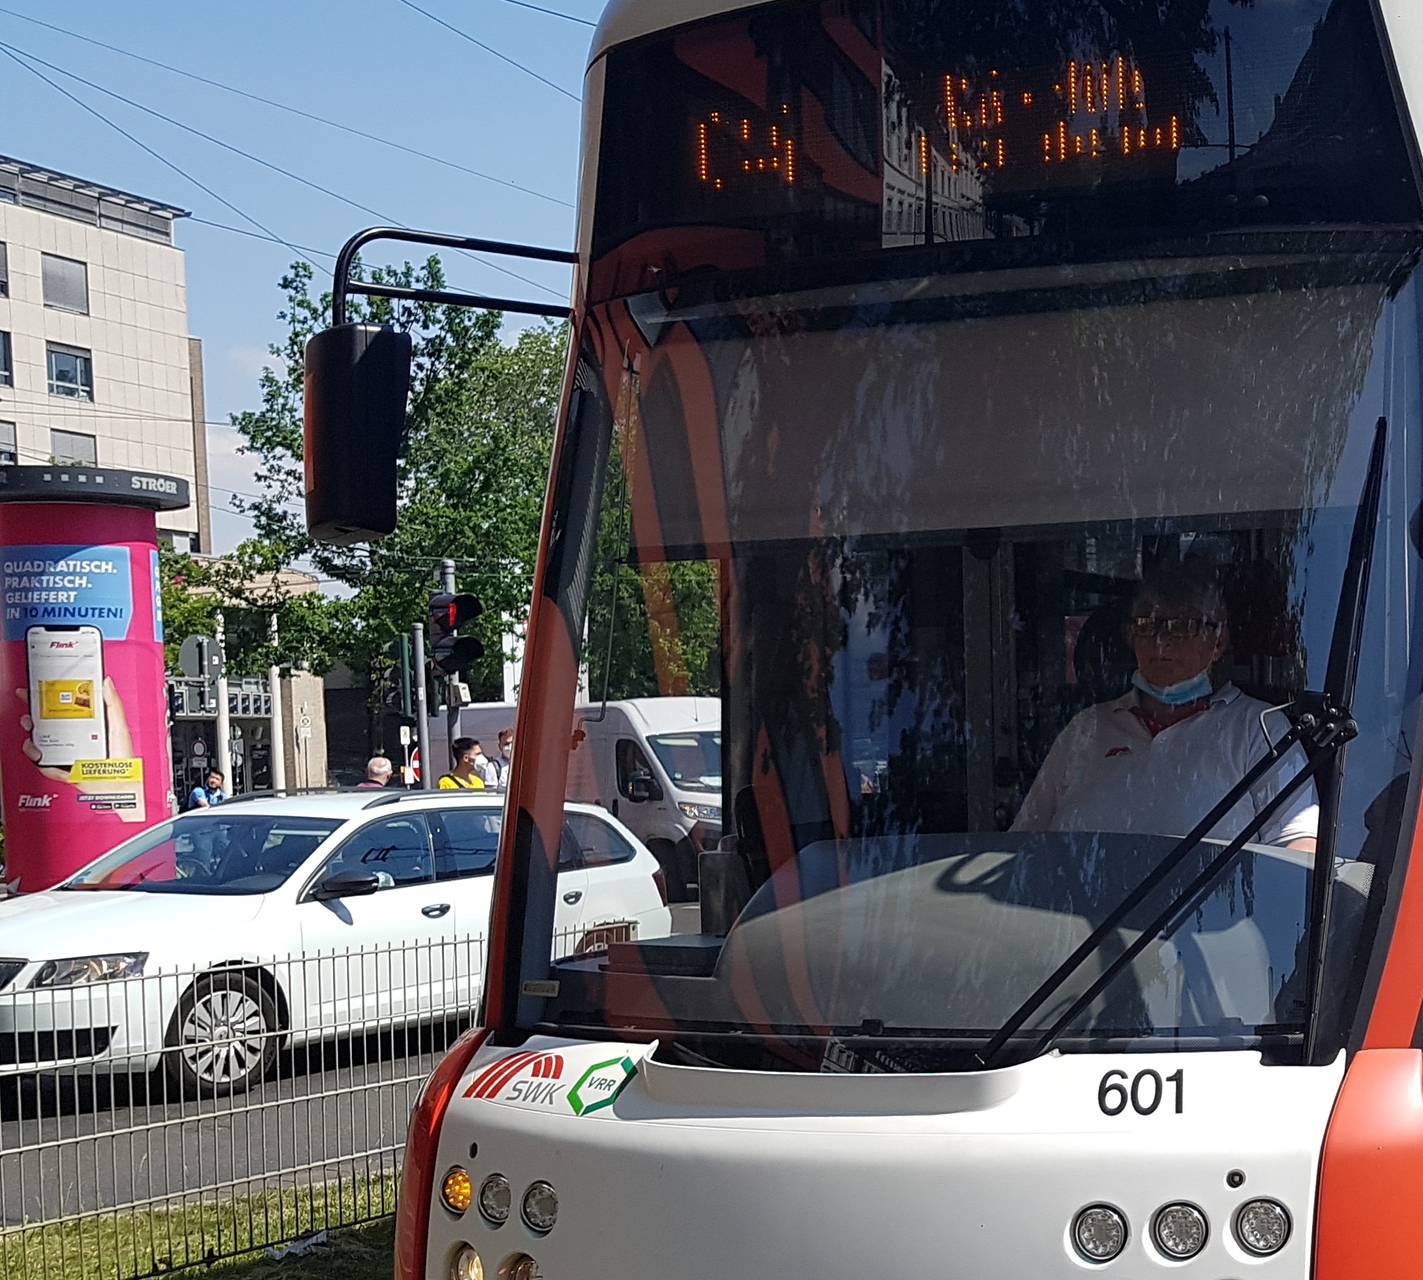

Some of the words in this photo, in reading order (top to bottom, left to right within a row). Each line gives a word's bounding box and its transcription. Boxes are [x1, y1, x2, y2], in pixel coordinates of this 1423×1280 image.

[131, 476, 178, 494] STRÖER
[4, 560, 118, 573] QUADRATISCH.
[4, 576, 92, 589] PRAKTISCH.
[6, 591, 78, 604] GELIEFERT
[6, 608, 21, 619] IN
[24, 607, 39, 618] 10
[42, 607, 123, 619] MINUTEN!
[49, 640, 75, 649] Flink
[18, 795, 53, 807] Flink
[588, 1076, 616, 1092] VRR
[506, 1080, 566, 1105] SWK
[1097, 1068, 1184, 1116] 601
